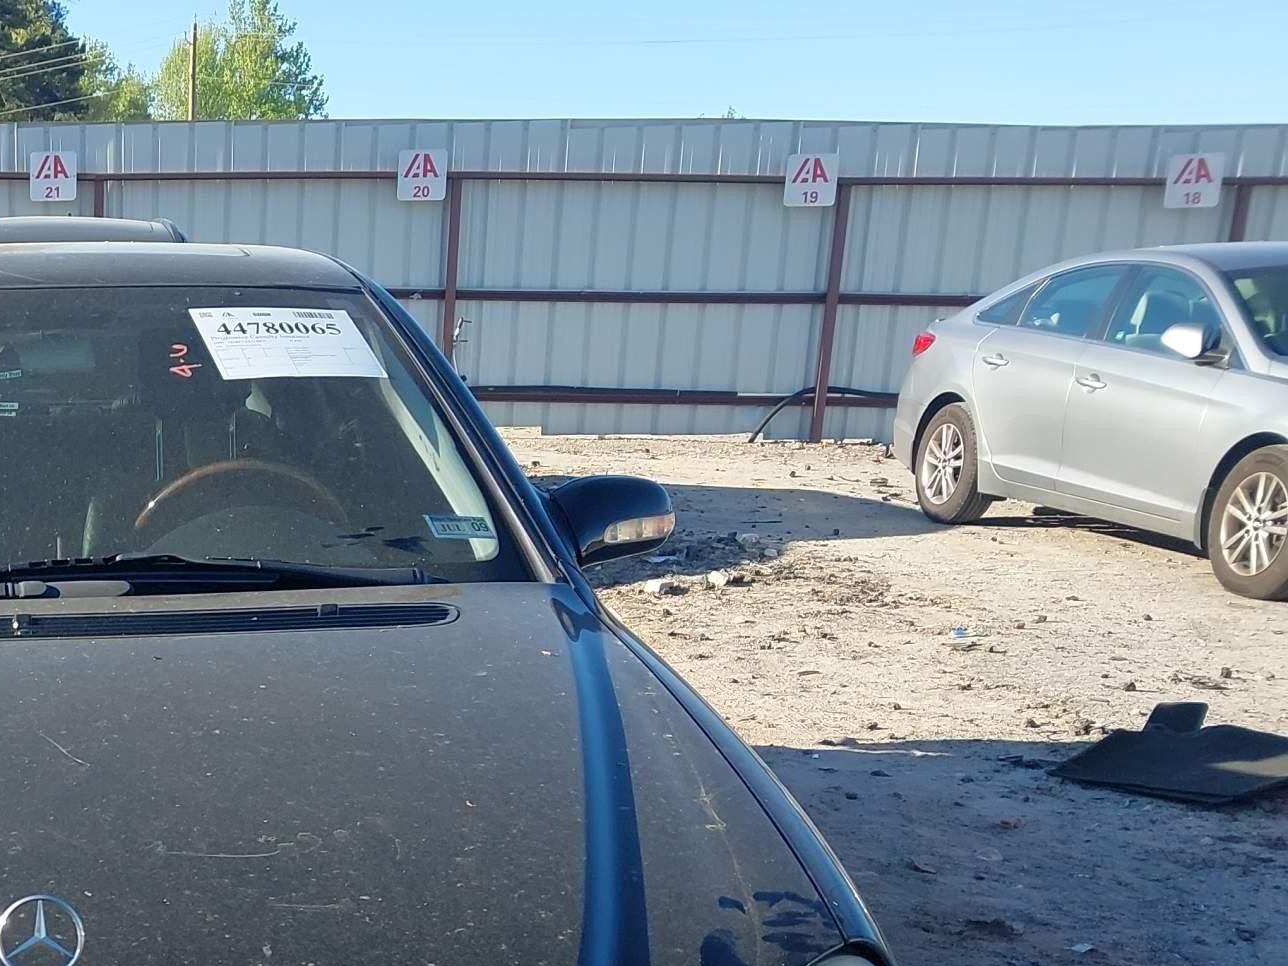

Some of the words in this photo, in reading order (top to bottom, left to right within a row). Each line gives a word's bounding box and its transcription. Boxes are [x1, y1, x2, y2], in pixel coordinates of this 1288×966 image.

[45, 186, 60, 198] 21
[413, 186, 430, 198] 20
[801, 191, 819, 204] 19
[1183, 191, 1201, 205] 18
[217, 321, 342, 336] 44780065
[472, 521, 489, 532] 09
